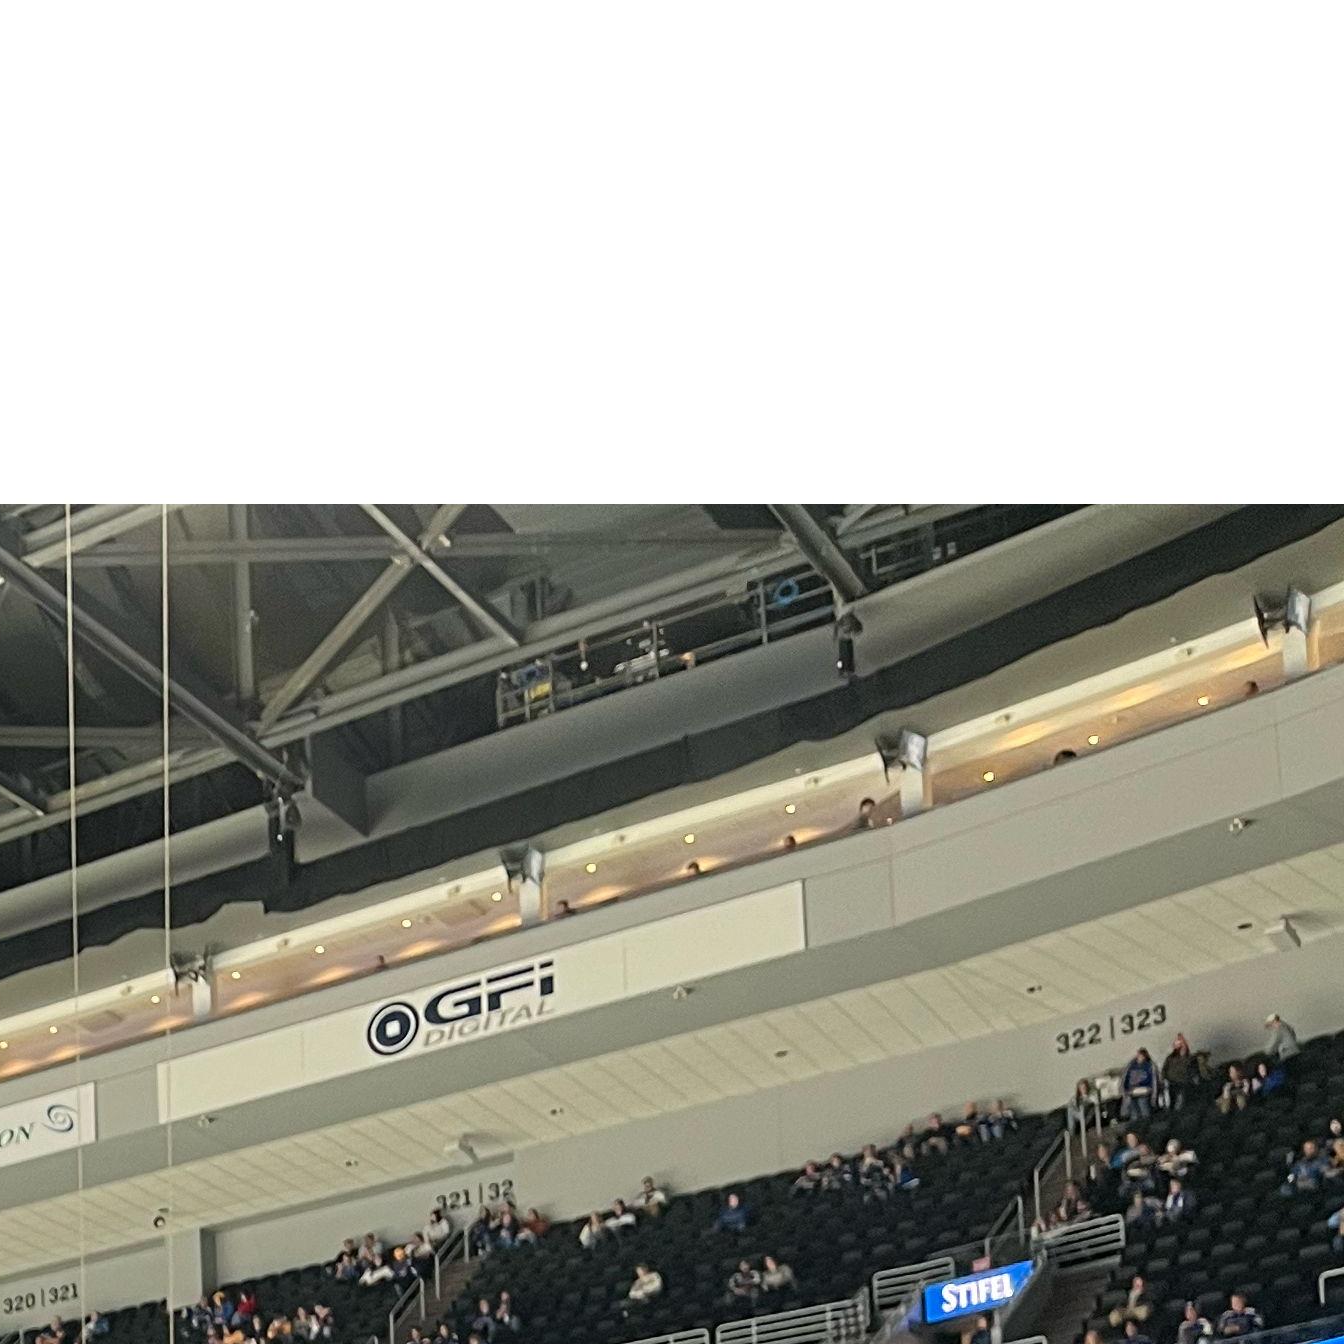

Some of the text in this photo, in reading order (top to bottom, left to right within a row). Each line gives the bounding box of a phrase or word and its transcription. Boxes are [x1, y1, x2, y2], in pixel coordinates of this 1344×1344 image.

[423, 1001, 557, 1047] DIGITAL
[1056, 1004, 1167, 1053] 322 323
[3, 1283, 78, 1314] 320 321
[941, 1273, 1014, 1313] STIFEL
